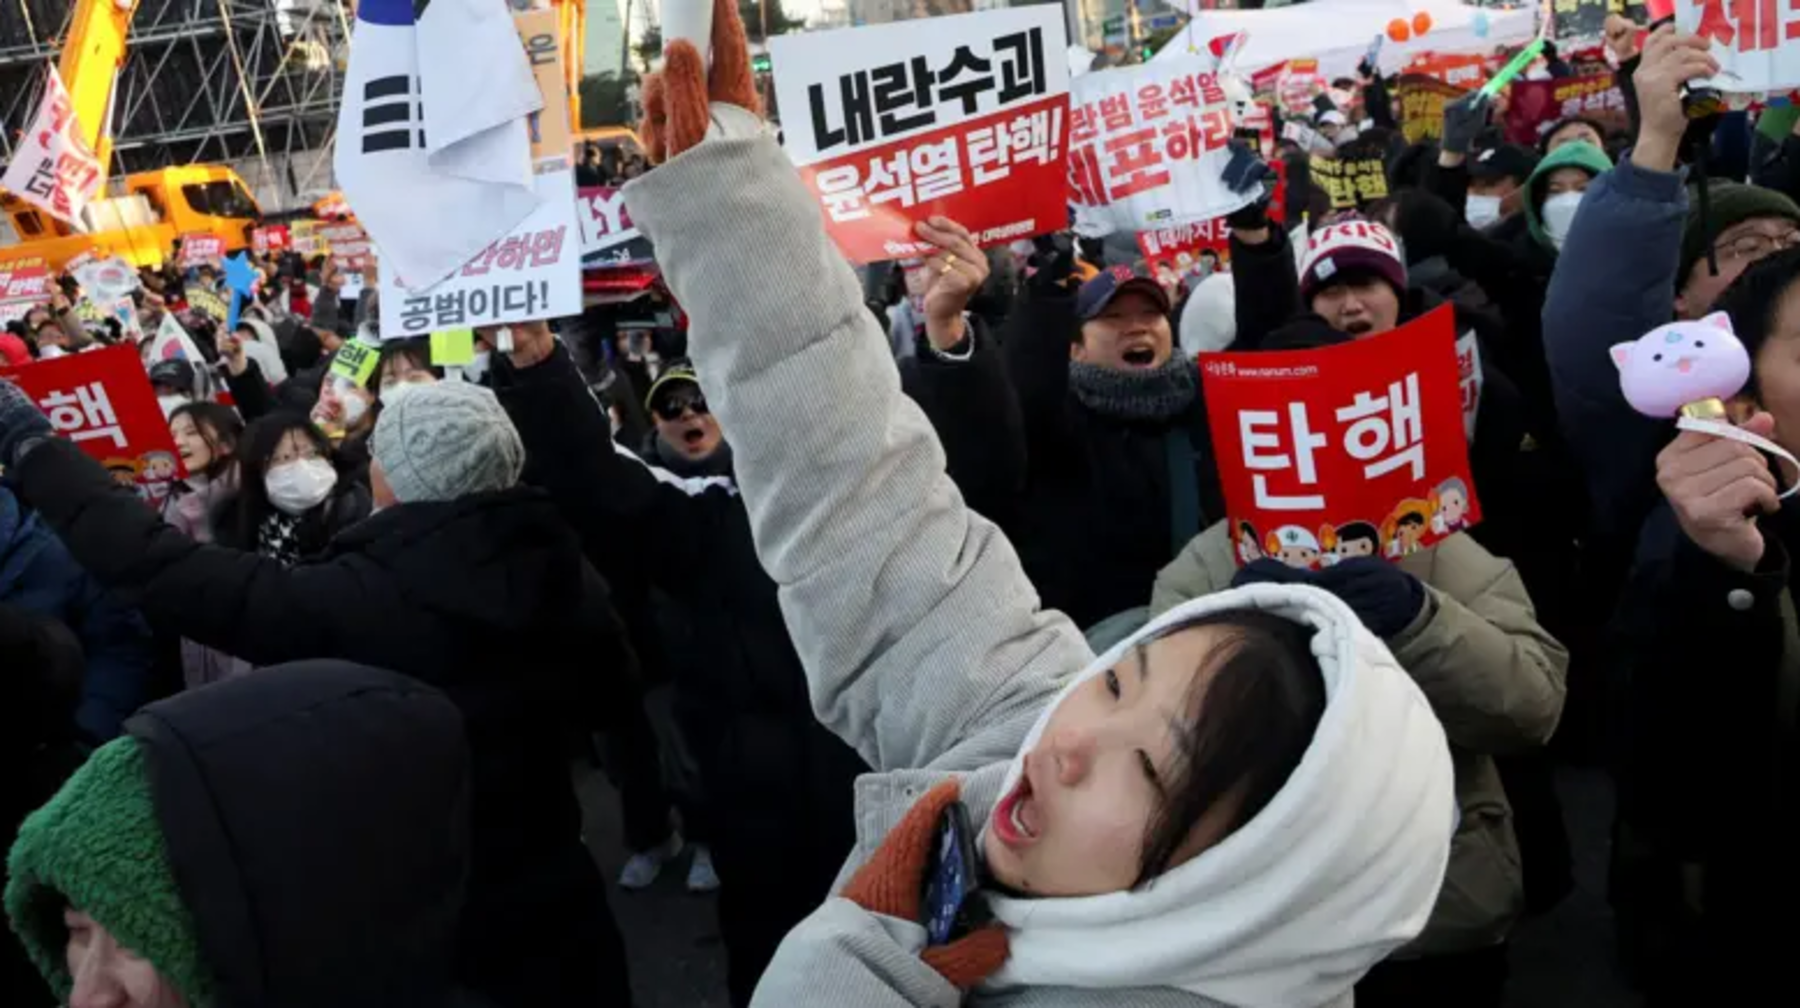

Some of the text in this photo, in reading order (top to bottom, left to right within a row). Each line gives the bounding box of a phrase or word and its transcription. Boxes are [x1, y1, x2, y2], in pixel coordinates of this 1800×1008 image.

[1692, 0, 1800, 53] 체
[807, 26, 1046, 152] 내란수괴
[1137, 69, 1226, 121] 윤석열
[815, 105, 1063, 222] 윤석열 탄핵!
[400, 280, 549, 331] 공범이다!
[1237, 371, 1426, 511] 탄핵
